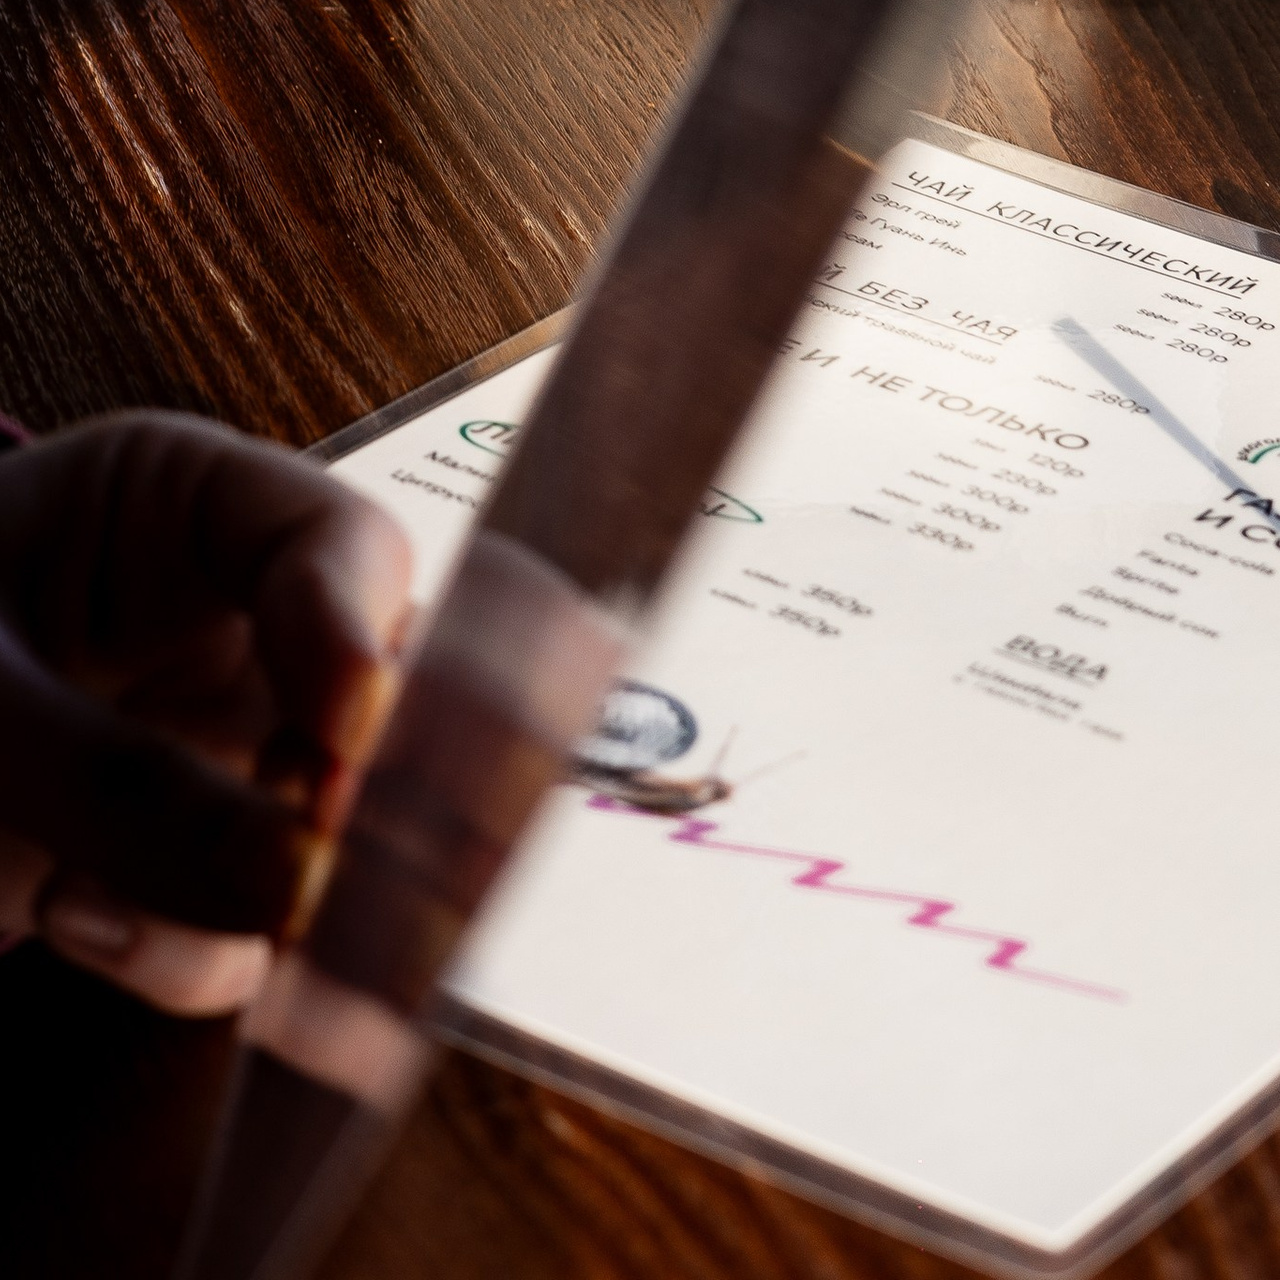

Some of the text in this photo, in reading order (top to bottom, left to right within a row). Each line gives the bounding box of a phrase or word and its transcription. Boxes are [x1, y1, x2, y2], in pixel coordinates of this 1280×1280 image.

[871, 193, 962, 229] Эрл грей
[870, 217, 925, 242] Гуань
[929, 237, 967, 256] Инь
[908, 171, 1259, 294] ЧАЙ КЛАССИЧЕСКИЙ
[857, 281, 1019, 341] БЕЗ ЧАЯ
[1213, 306, 1276, 332] 280р
[864, 316, 956, 353] травяной
[960, 349, 997, 365] чай
[1165, 338, 1229, 366] 280р
[1188, 322, 1252, 349] 280р
[799, 348, 841, 369] И
[850, 365, 914, 394] НЕ
[919, 385, 1090, 450] ТОЛЬКО
[1087, 389, 1151, 416] 280р
[1193, 508, 1235, 529] И
[1006, 634, 1108, 680] ВОДА
